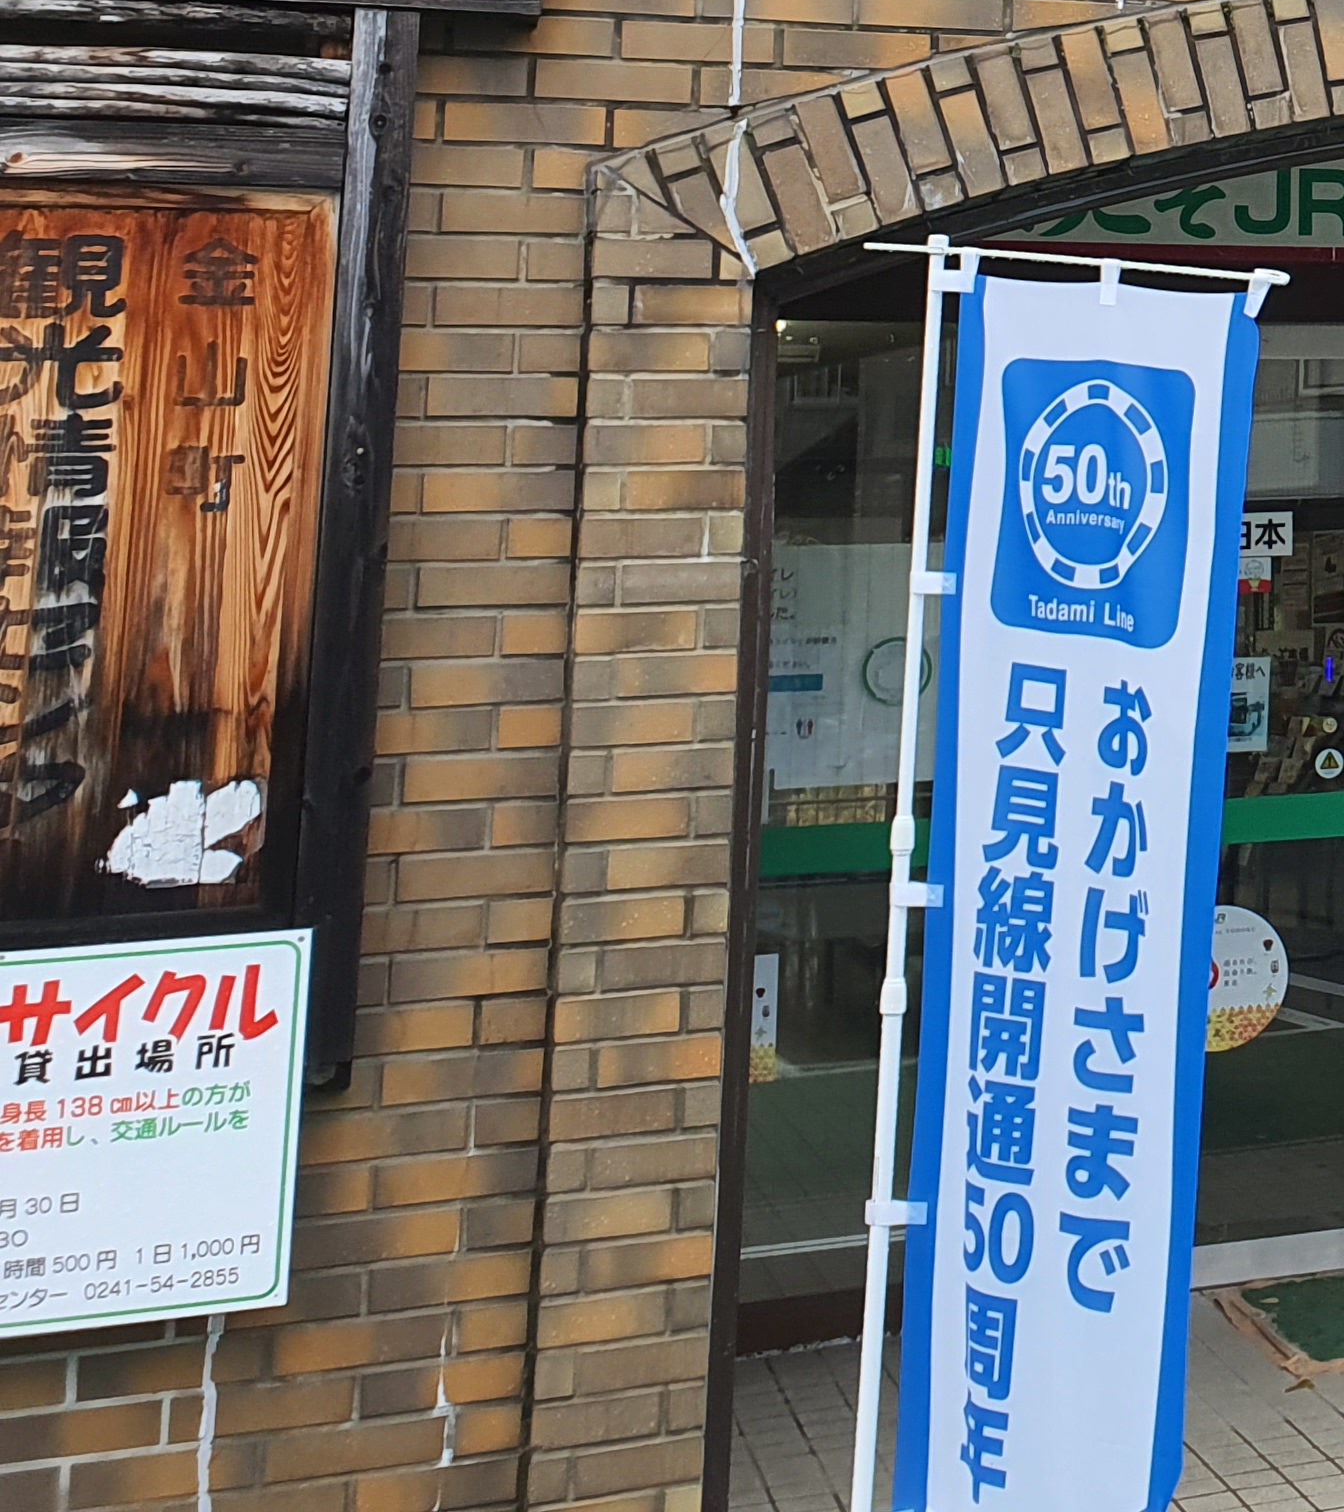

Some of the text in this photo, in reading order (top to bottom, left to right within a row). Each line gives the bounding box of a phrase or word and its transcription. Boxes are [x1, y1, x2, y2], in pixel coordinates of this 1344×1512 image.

[165, 239, 259, 513] 金山町
[1041, 443, 1132, 510] 50th
[1046, 509, 1125, 535] Anniversary
[1028, 594, 1135, 633] Tadami Line
[0, 963, 279, 1047] サイクル
[1058, 678, 1153, 1315] おかげさまで
[13, 1031, 236, 1086] 貸出場所
[959, 659, 1070, 1505] 只見線開通50周年
[84, 1266, 240, 1300] 0241-54-2855
